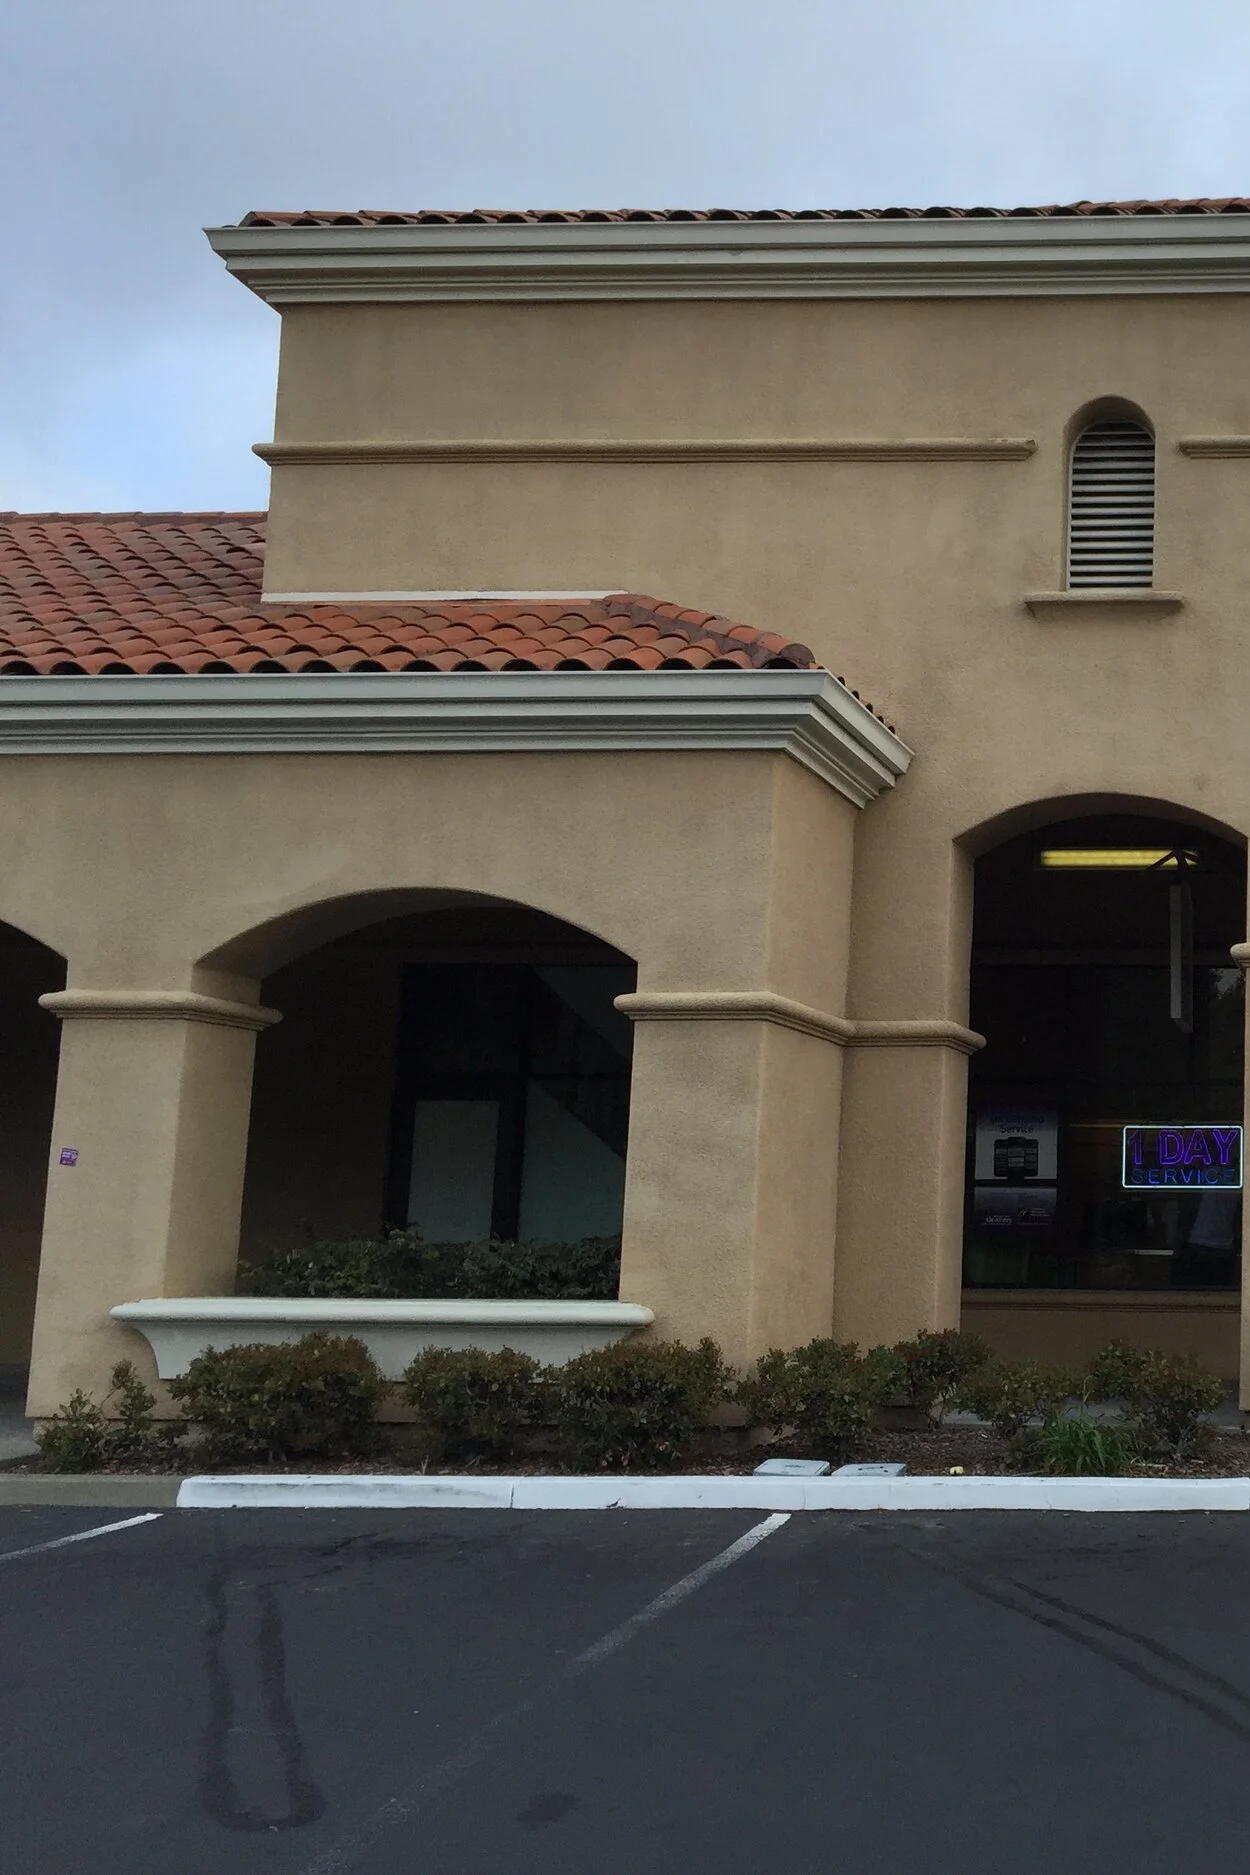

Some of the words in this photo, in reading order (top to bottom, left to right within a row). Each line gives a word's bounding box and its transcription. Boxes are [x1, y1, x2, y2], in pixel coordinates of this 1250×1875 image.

[1128, 1129, 1142, 1165] 1
[1159, 1129, 1239, 1165] DAY
[1131, 1168, 1235, 1185] SERVICE
